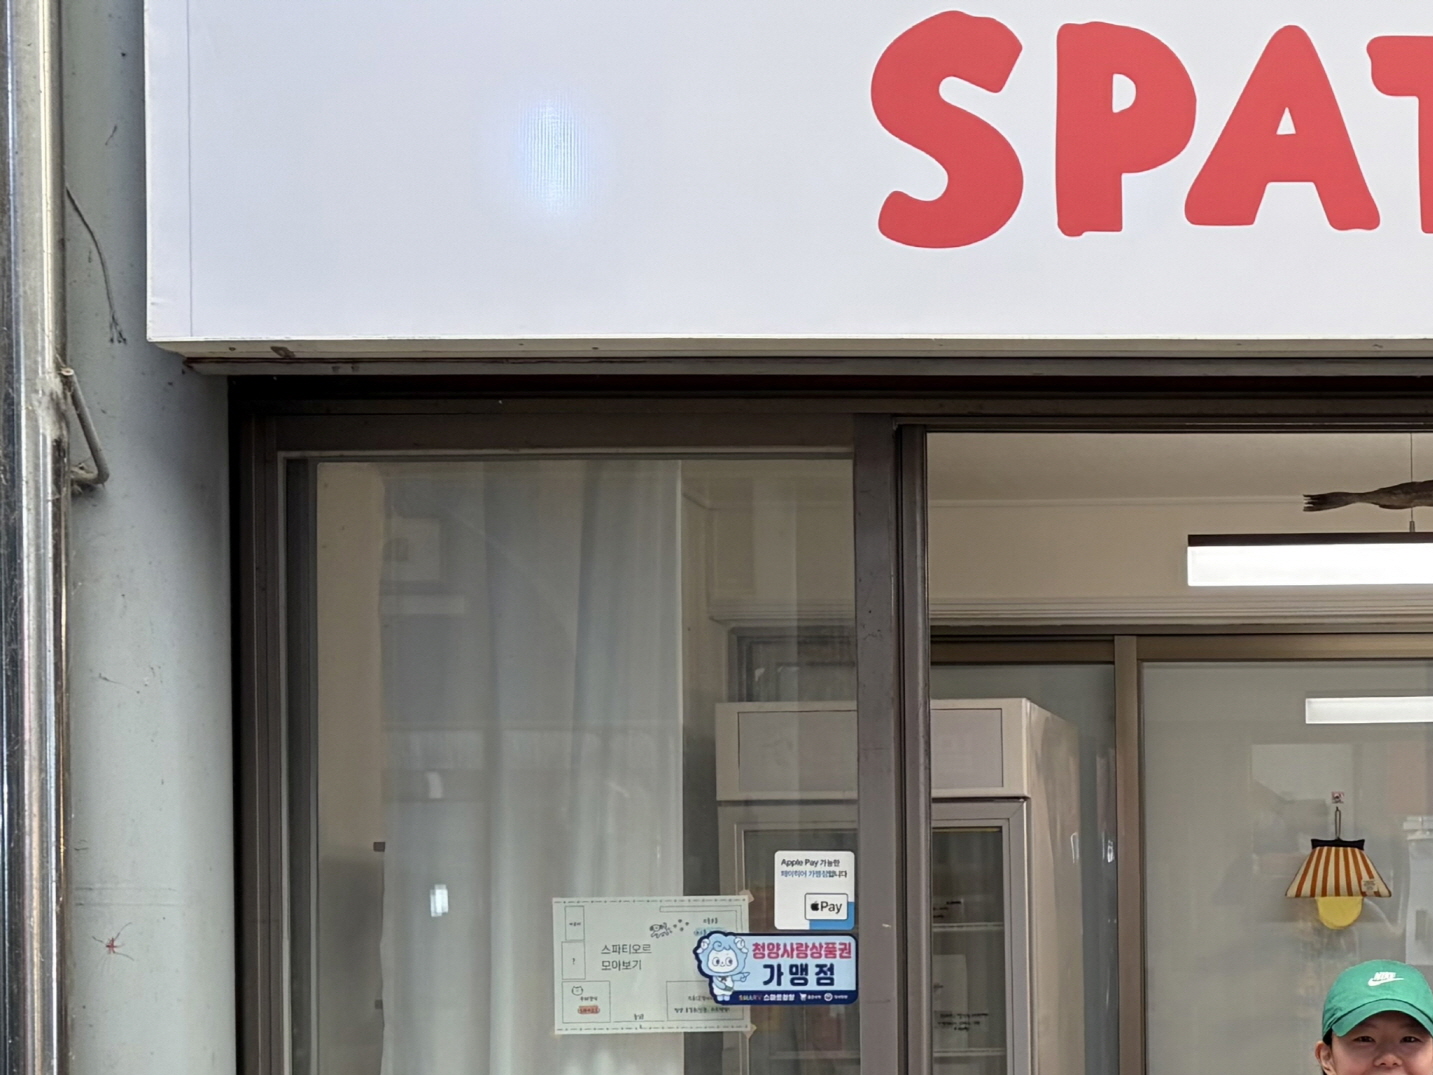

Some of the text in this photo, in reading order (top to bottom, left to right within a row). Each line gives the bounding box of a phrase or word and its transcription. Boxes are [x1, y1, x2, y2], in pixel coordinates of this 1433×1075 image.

[781, 858, 803, 867] Apple
[805, 858, 818, 867] Pay
[820, 901, 842, 914] Pay
[601, 944, 652, 955] 스파티오르
[752, 942, 852, 960] 청양사랑상품권
[601, 959, 642, 972] 모아보기
[762, 962, 835, 987] 가맹점
